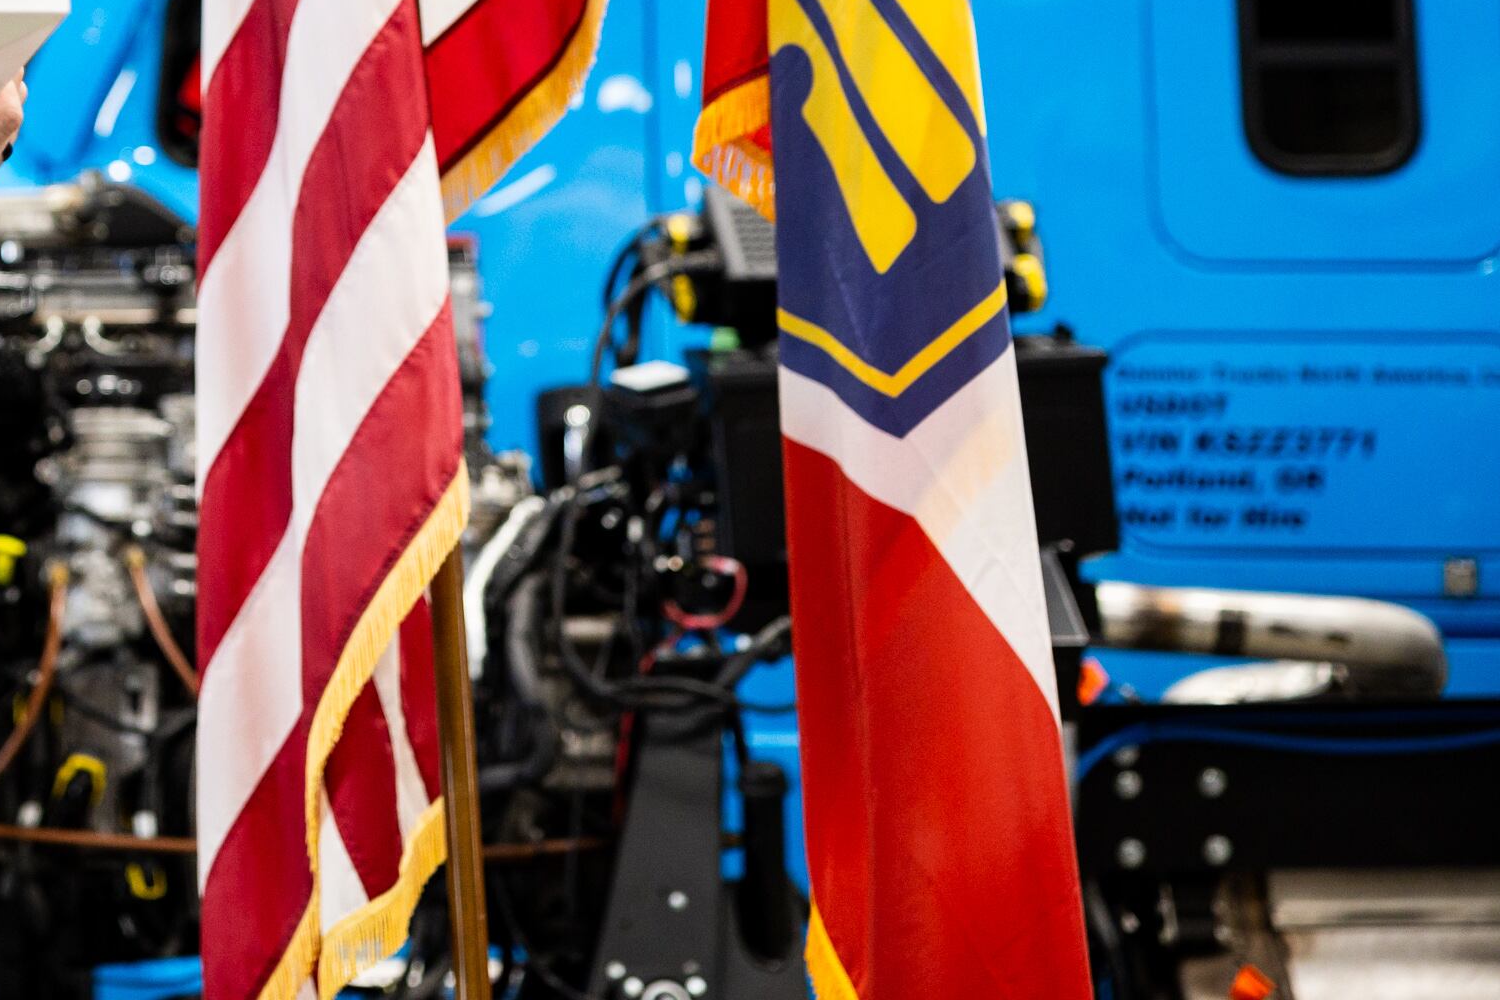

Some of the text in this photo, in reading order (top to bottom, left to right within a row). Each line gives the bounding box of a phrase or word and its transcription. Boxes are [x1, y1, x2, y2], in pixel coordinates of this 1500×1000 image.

[1118, 427, 1181, 456] VIN
[1275, 466, 1324, 492] OR
[1119, 504, 1310, 532] Not for Hire
